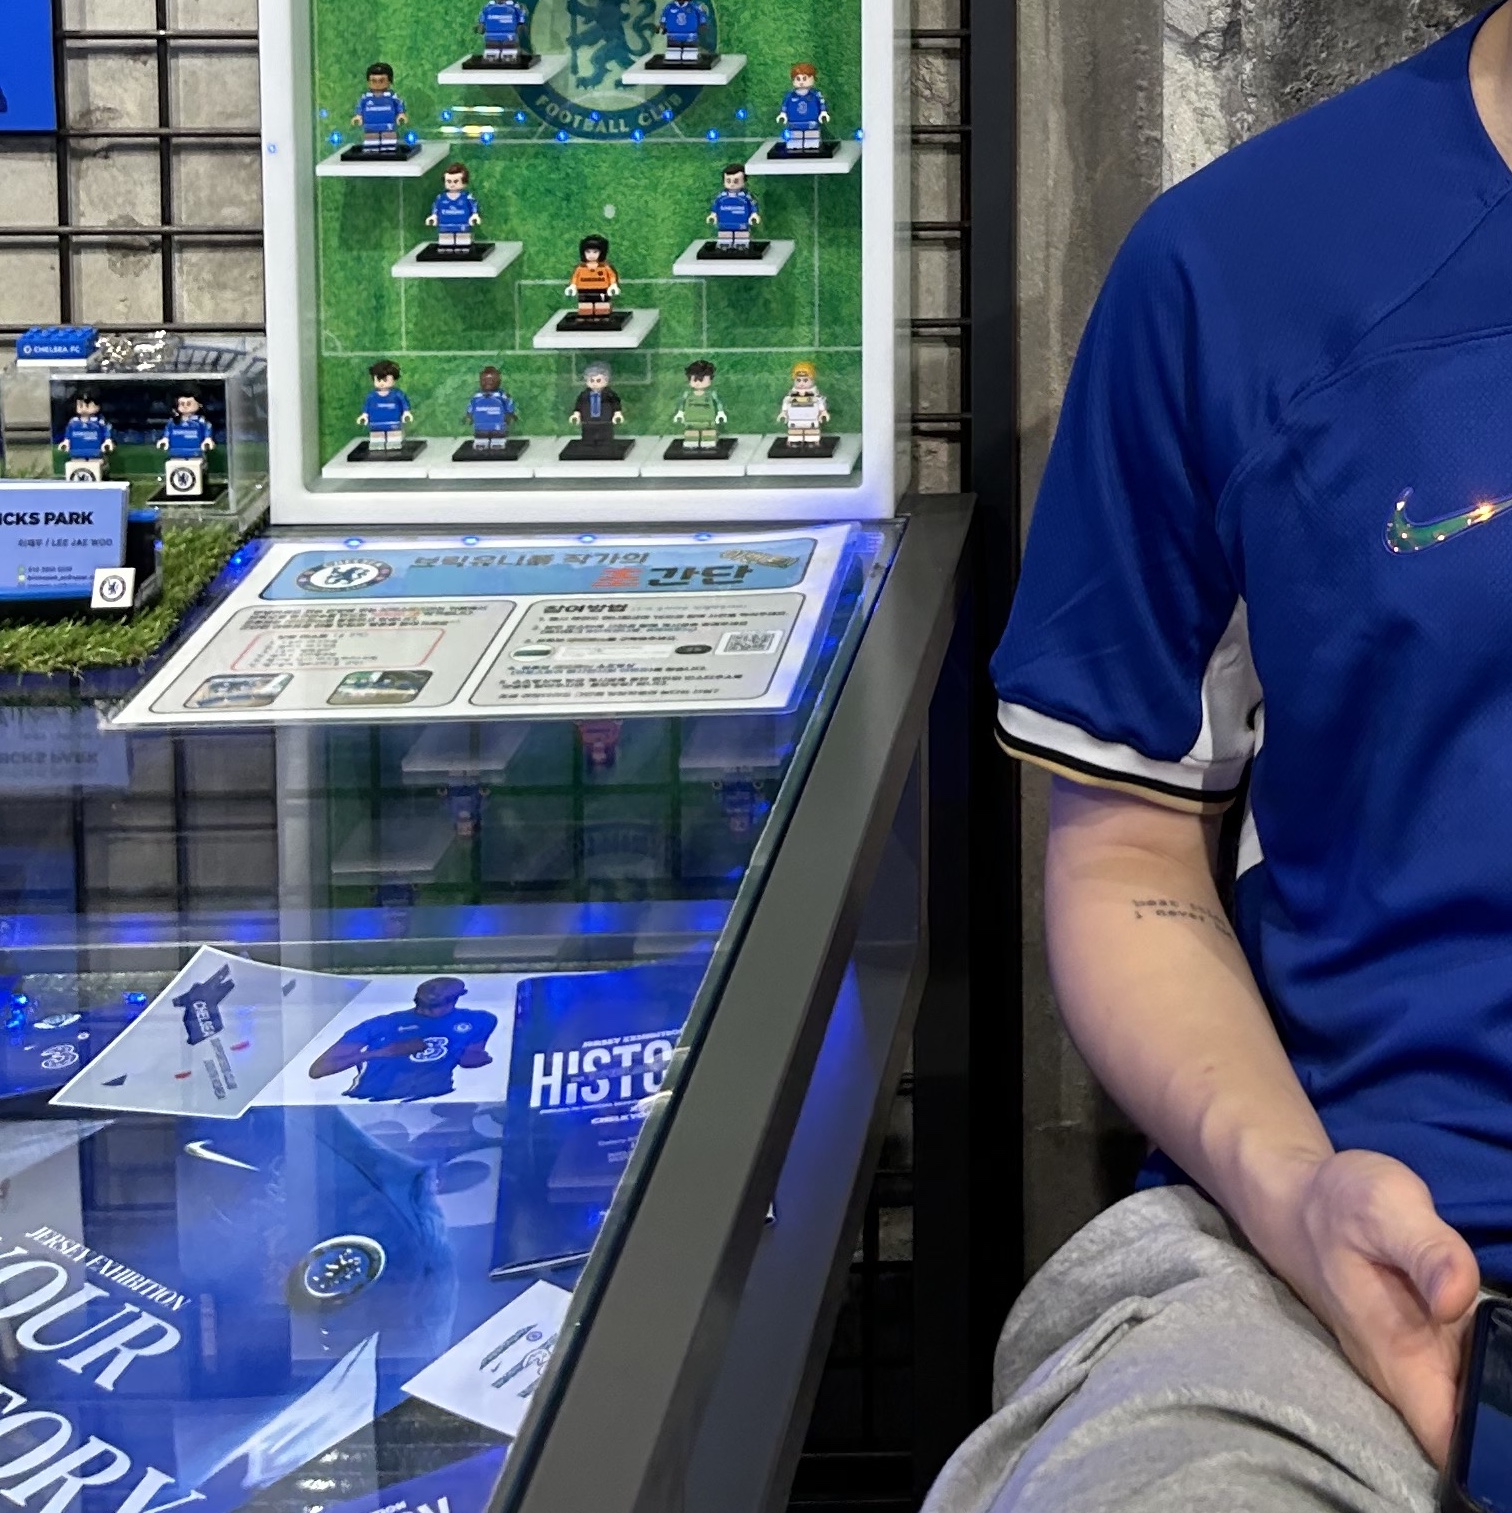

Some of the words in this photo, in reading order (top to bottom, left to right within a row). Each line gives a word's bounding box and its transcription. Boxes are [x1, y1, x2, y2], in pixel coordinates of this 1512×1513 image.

[536, 95, 629, 134] FOOTBALL
[33, 344, 68, 354] CHELSEA
[70, 345, 80, 354] FC
[44, 511, 94, 525] PARK
[25, 1226, 88, 1264] JERSEY
[86, 1253, 191, 1312] EXHIBITION
[0, 1246, 182, 1392] OUR
